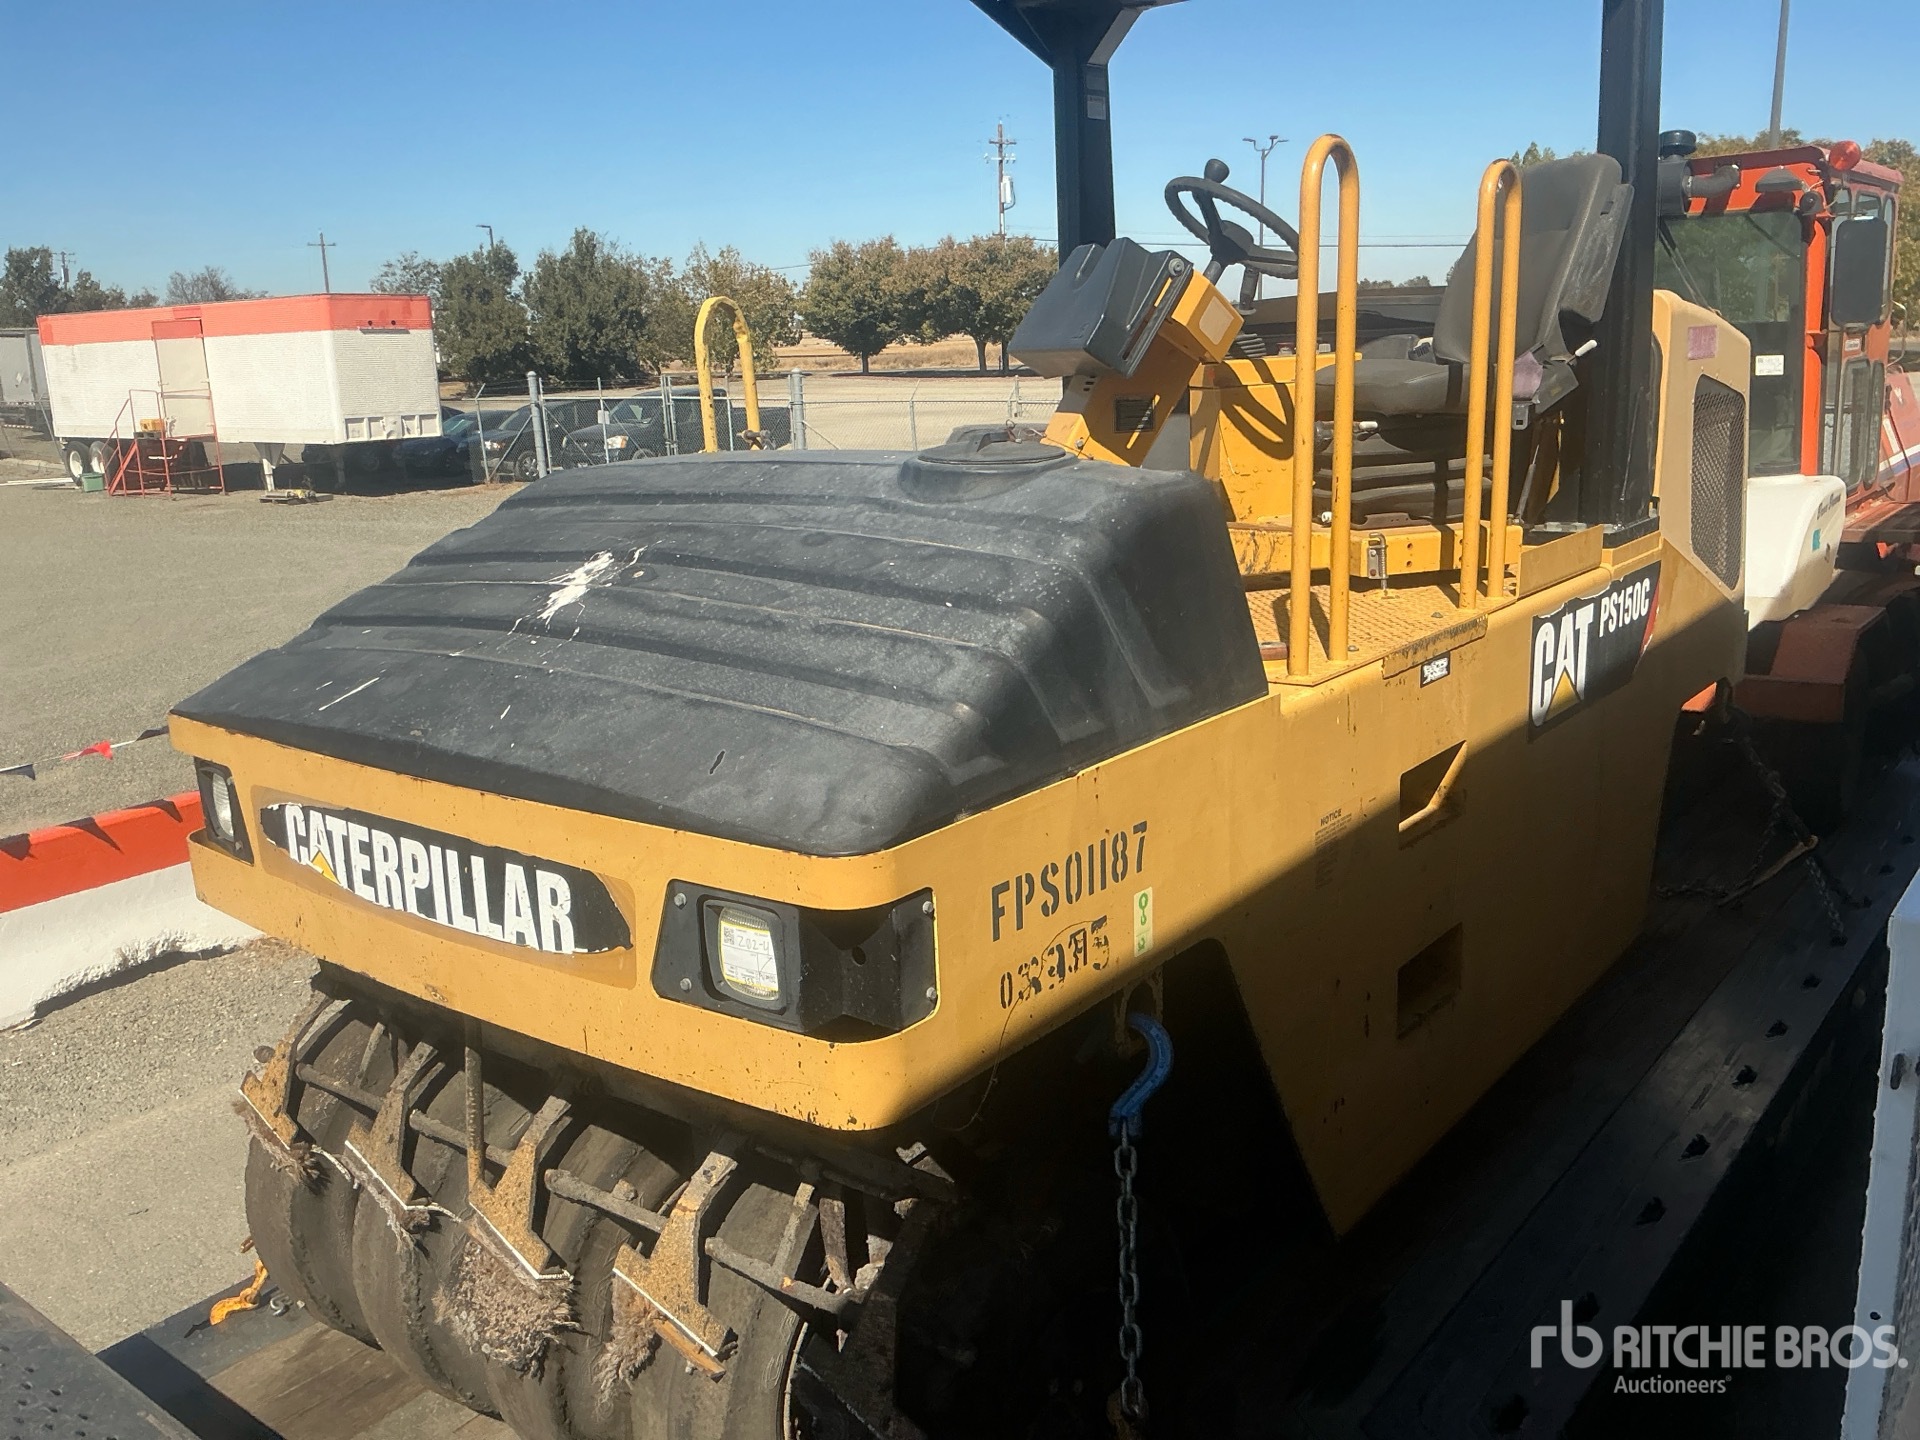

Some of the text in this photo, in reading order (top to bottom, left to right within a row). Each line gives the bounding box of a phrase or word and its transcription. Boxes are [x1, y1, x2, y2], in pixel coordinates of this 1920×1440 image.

[1532, 577, 1650, 727] CAT PS150C
[284, 804, 575, 955] CATERPILLAR
[991, 820, 1148, 942] FPS01187
[1320, 808, 1342, 826] NOTICE
